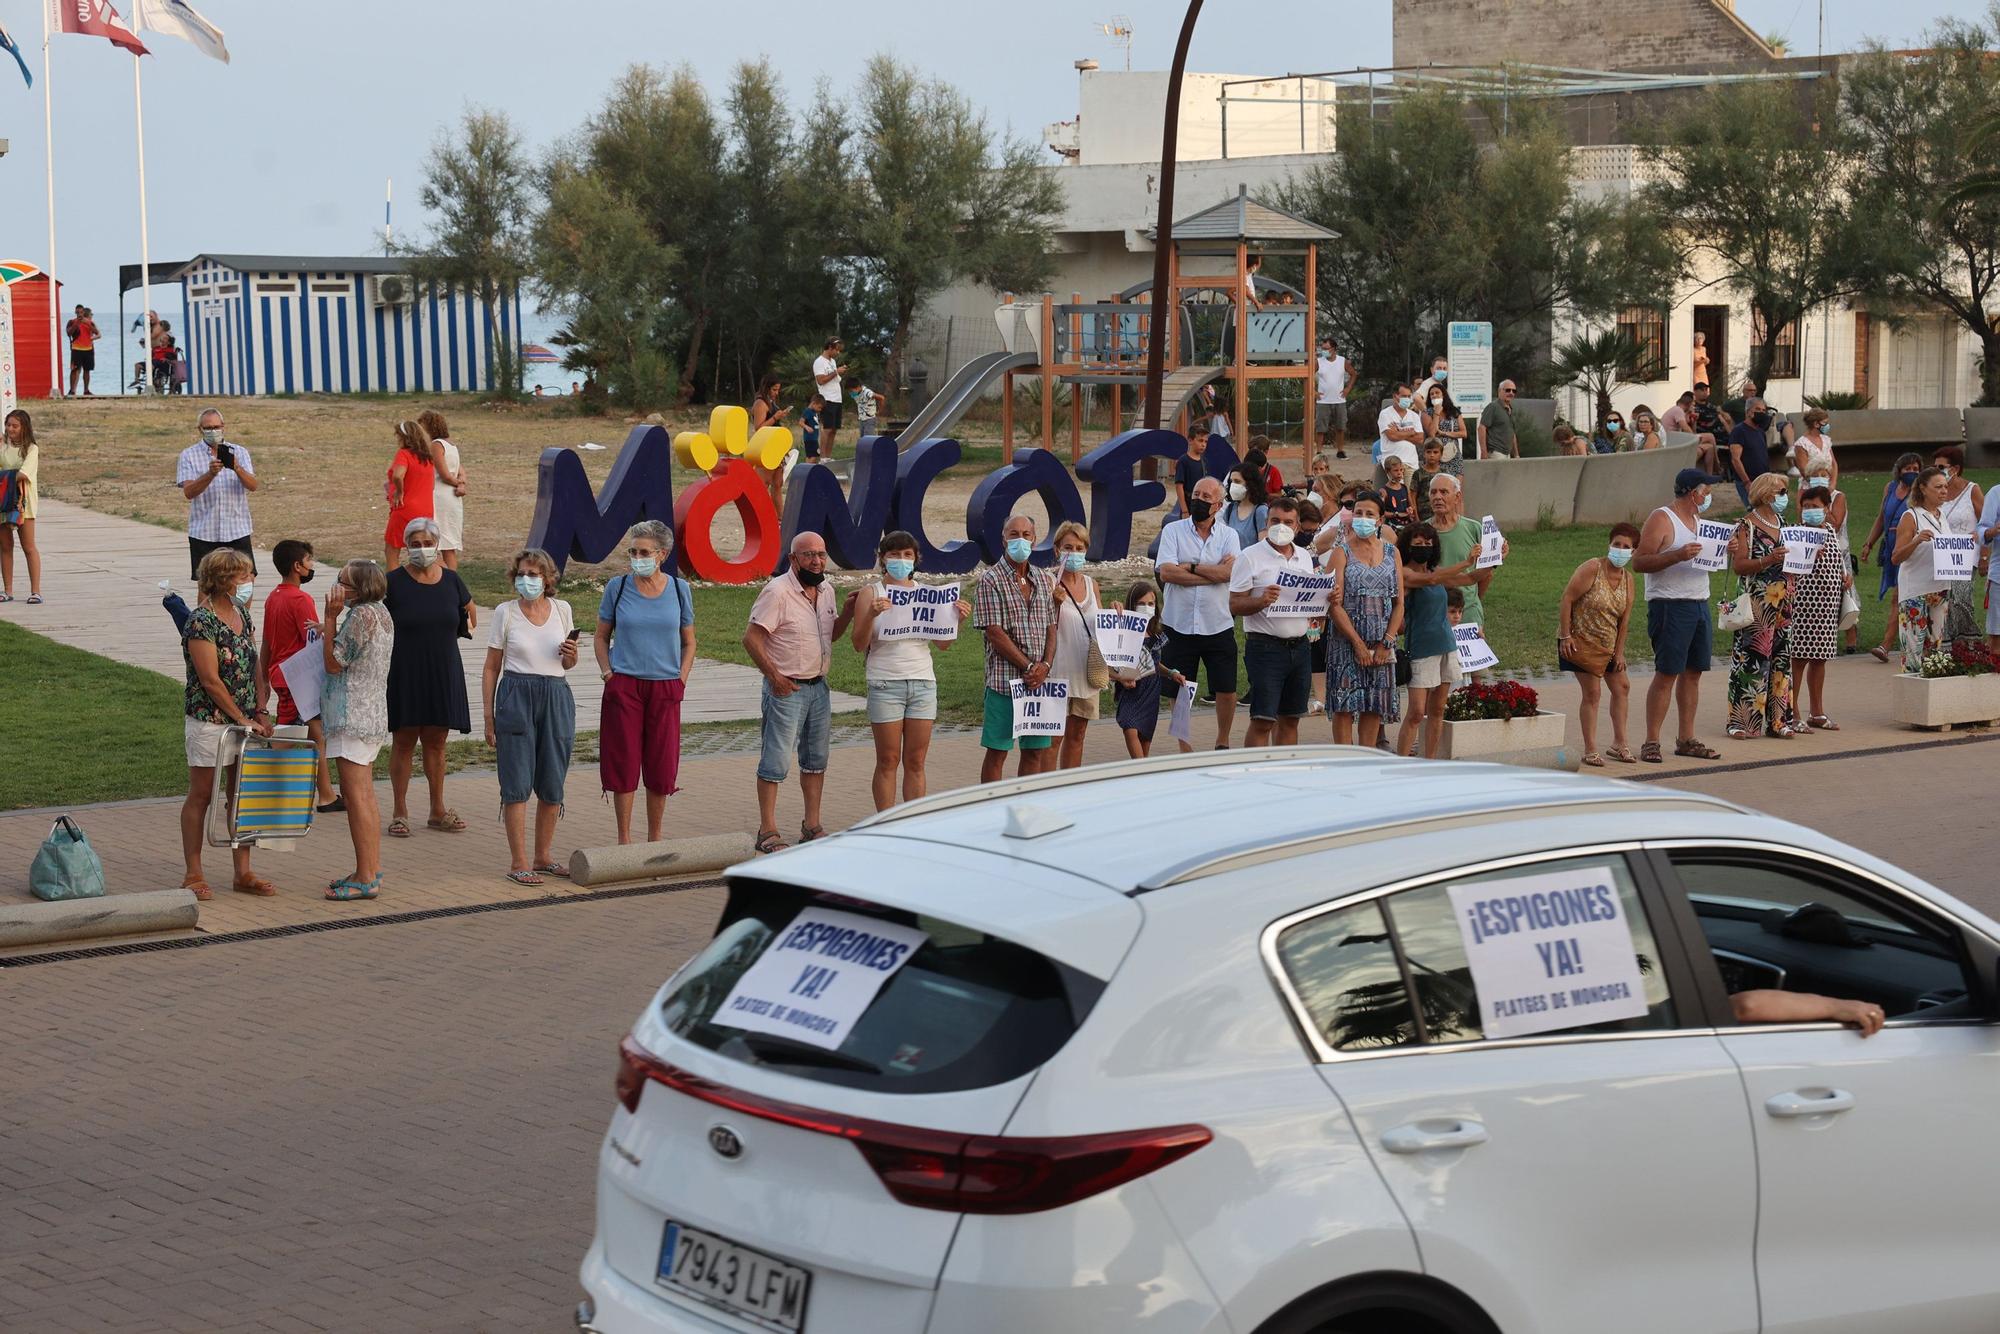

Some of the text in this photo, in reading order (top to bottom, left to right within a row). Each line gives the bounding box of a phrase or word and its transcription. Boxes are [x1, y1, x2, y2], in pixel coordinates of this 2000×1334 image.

[1951, 553, 1964, 566] YA!
[887, 586, 959, 606] ¡ESPIGONES
[1295, 591, 1316, 603] YA!
[912, 606, 936, 622] YA!
[883, 625, 954, 636] PLATGES DE MONCOFA
[1030, 722, 1061, 730] MONCOFA
[1466, 884, 1617, 945] ¡ESPIGONES
[776, 921, 909, 971] ¡ESPIGONES
[1535, 938, 1584, 978] YA!
[789, 964, 839, 1000] YA!
[730, 995, 773, 1016] PLATGES
[771, 1003, 788, 1020] DE
[1493, 982, 1632, 1018] PLATGES DE MONCOFA
[675, 1236, 740, 1295] 7943
